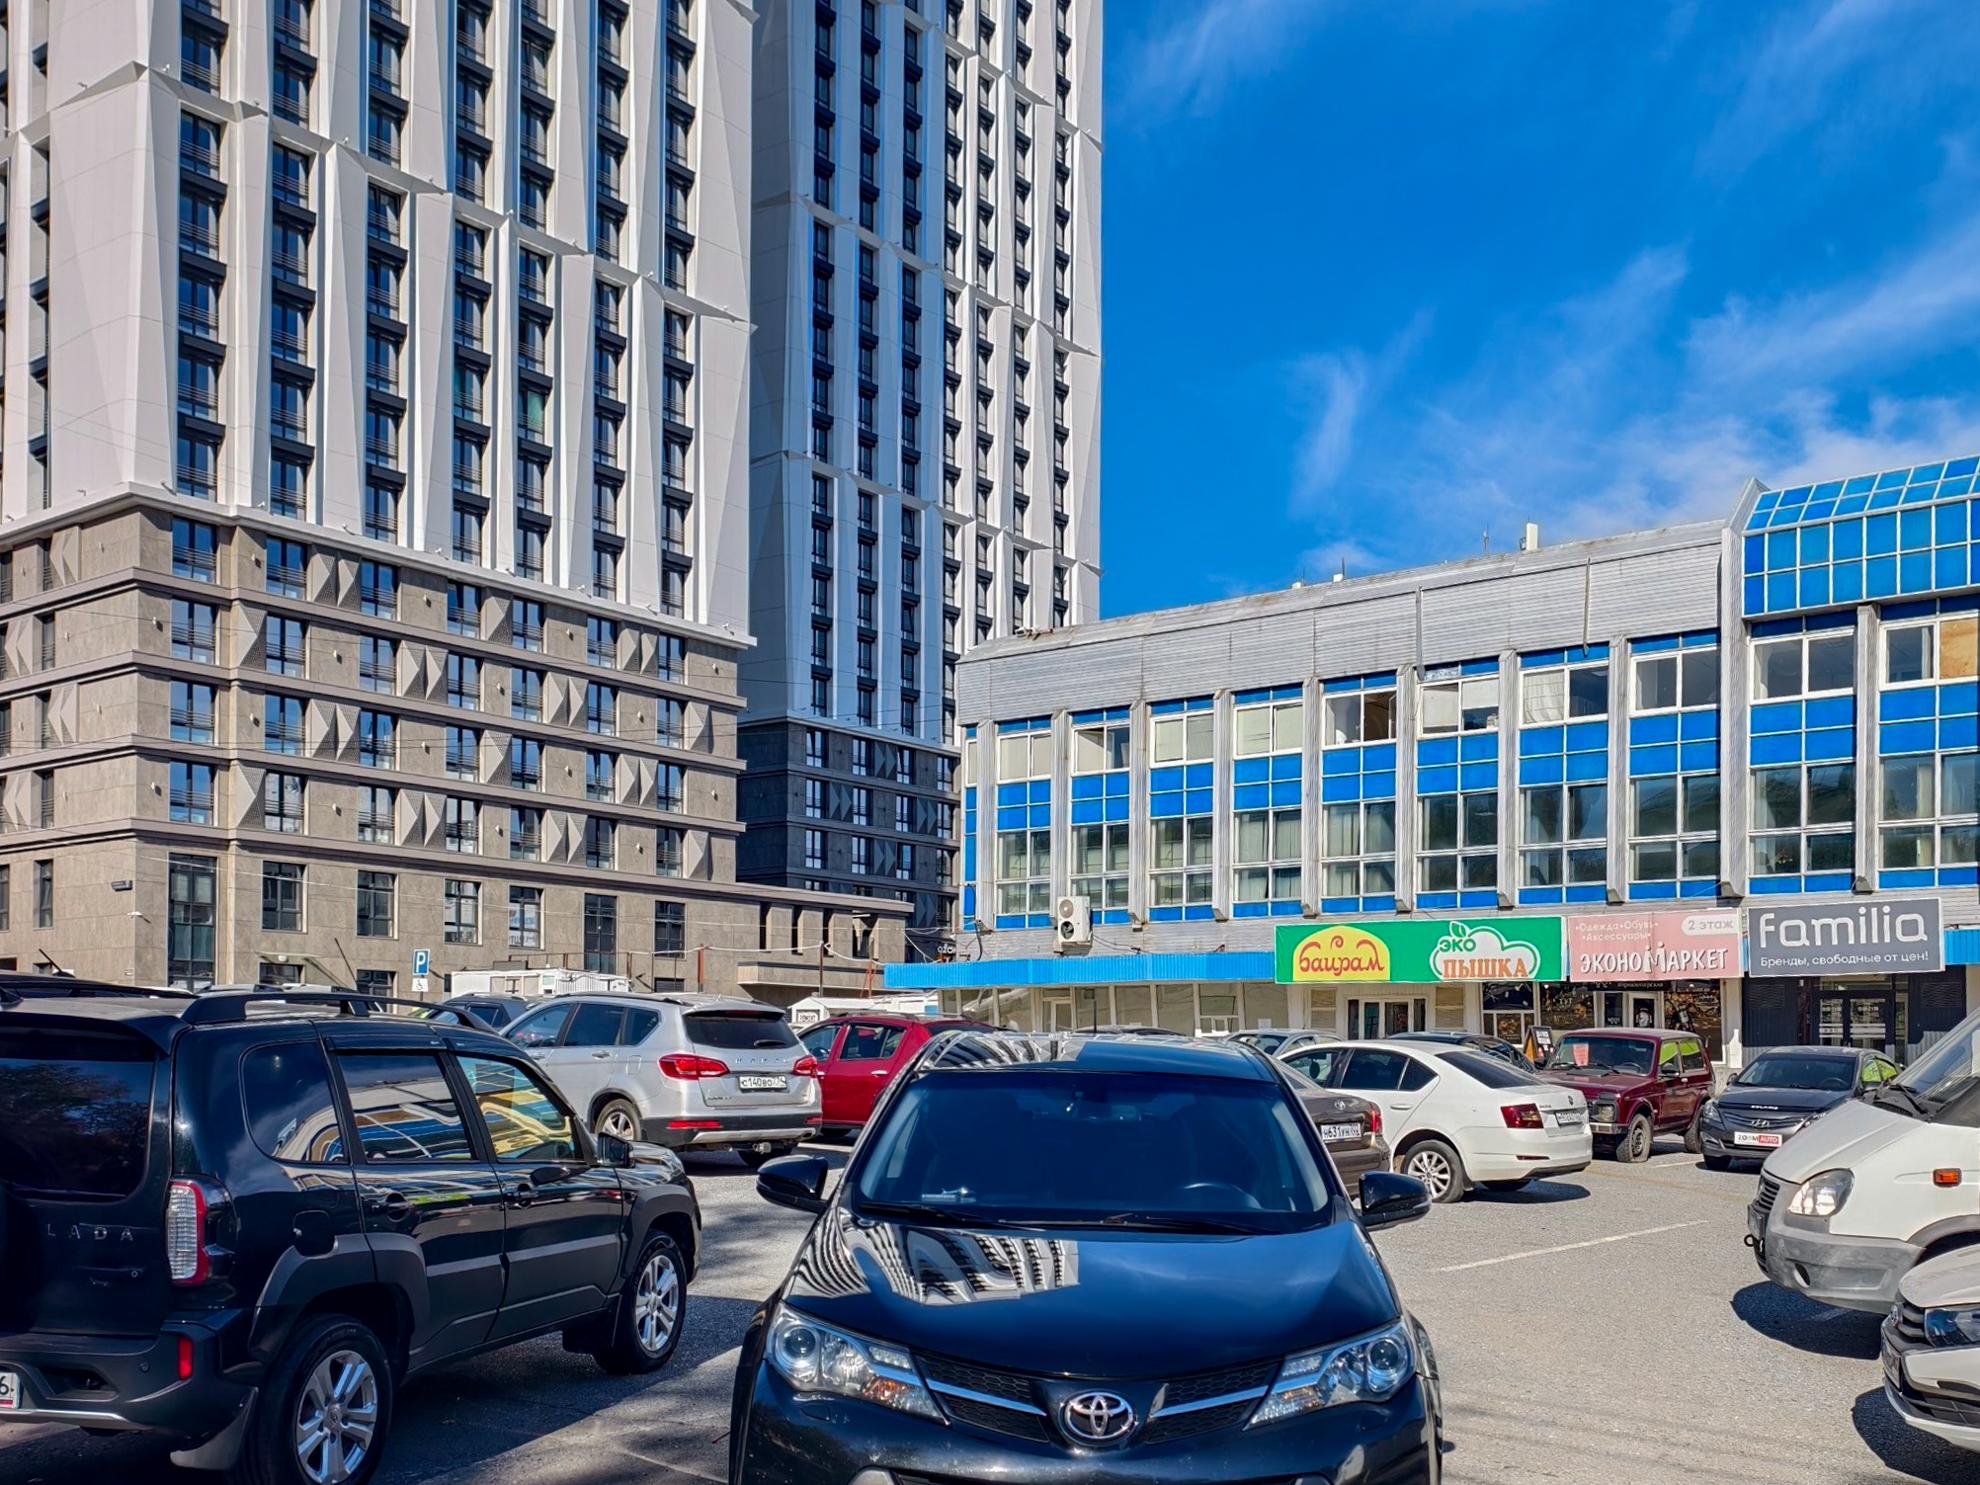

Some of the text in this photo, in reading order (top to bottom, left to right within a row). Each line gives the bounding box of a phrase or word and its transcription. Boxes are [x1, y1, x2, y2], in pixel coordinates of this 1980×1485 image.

[1579, 922, 1619, 932] Одежда
[1688, 919, 1734, 930] 2 этаж
[1587, 931, 1649, 942] Аксессуары
[1580, 943, 1728, 973] ЭКОНОМАРКЕТ
[1760, 951, 1929, 968] Бренды, свободные от цен!
[1443, 958, 1528, 978] ПЫШКА
[47, 1223, 134, 1242] LADA
